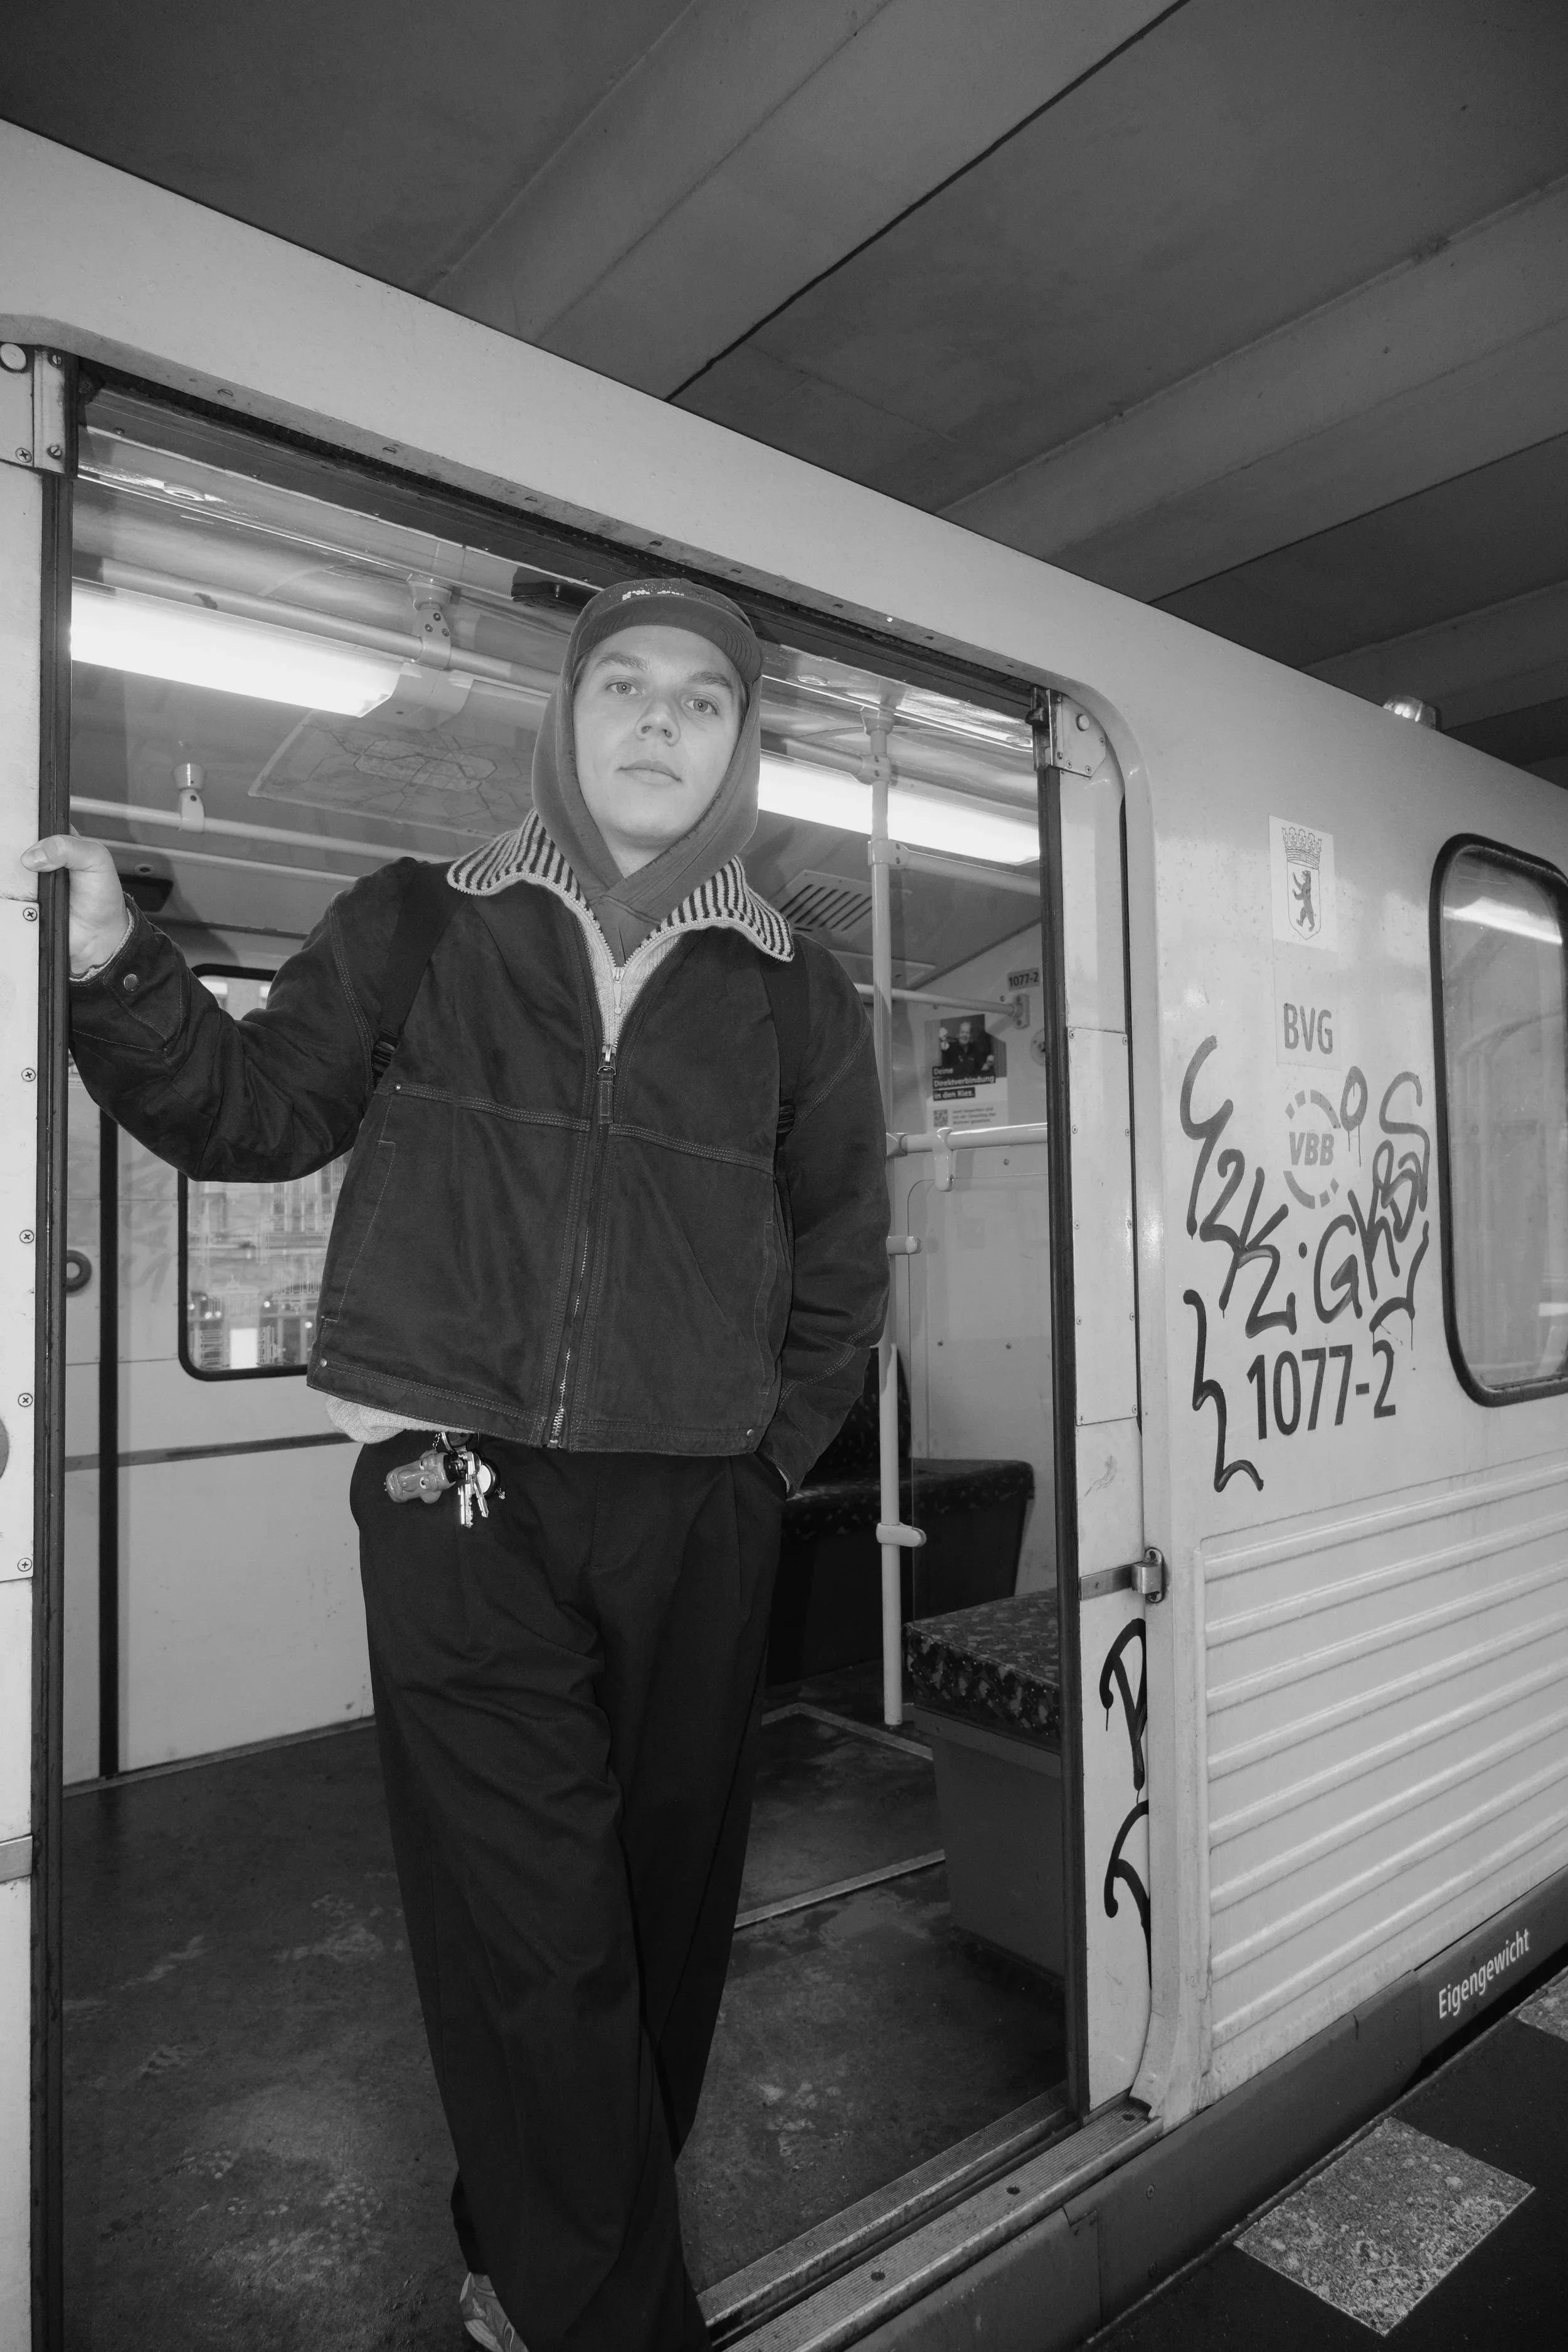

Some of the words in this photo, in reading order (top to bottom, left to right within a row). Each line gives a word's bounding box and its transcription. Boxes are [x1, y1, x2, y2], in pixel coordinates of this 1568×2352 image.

[1009, 972, 1039, 987] 1077-2
[1284, 1003, 1333, 1054] BVG
[934, 1076, 995, 1088] Direktverbindung
[1290, 1131, 1334, 1166] VBB
[1246, 1338, 1396, 1440] 1077-2
[1438, 1928, 1530, 2020] Eigengewicht
